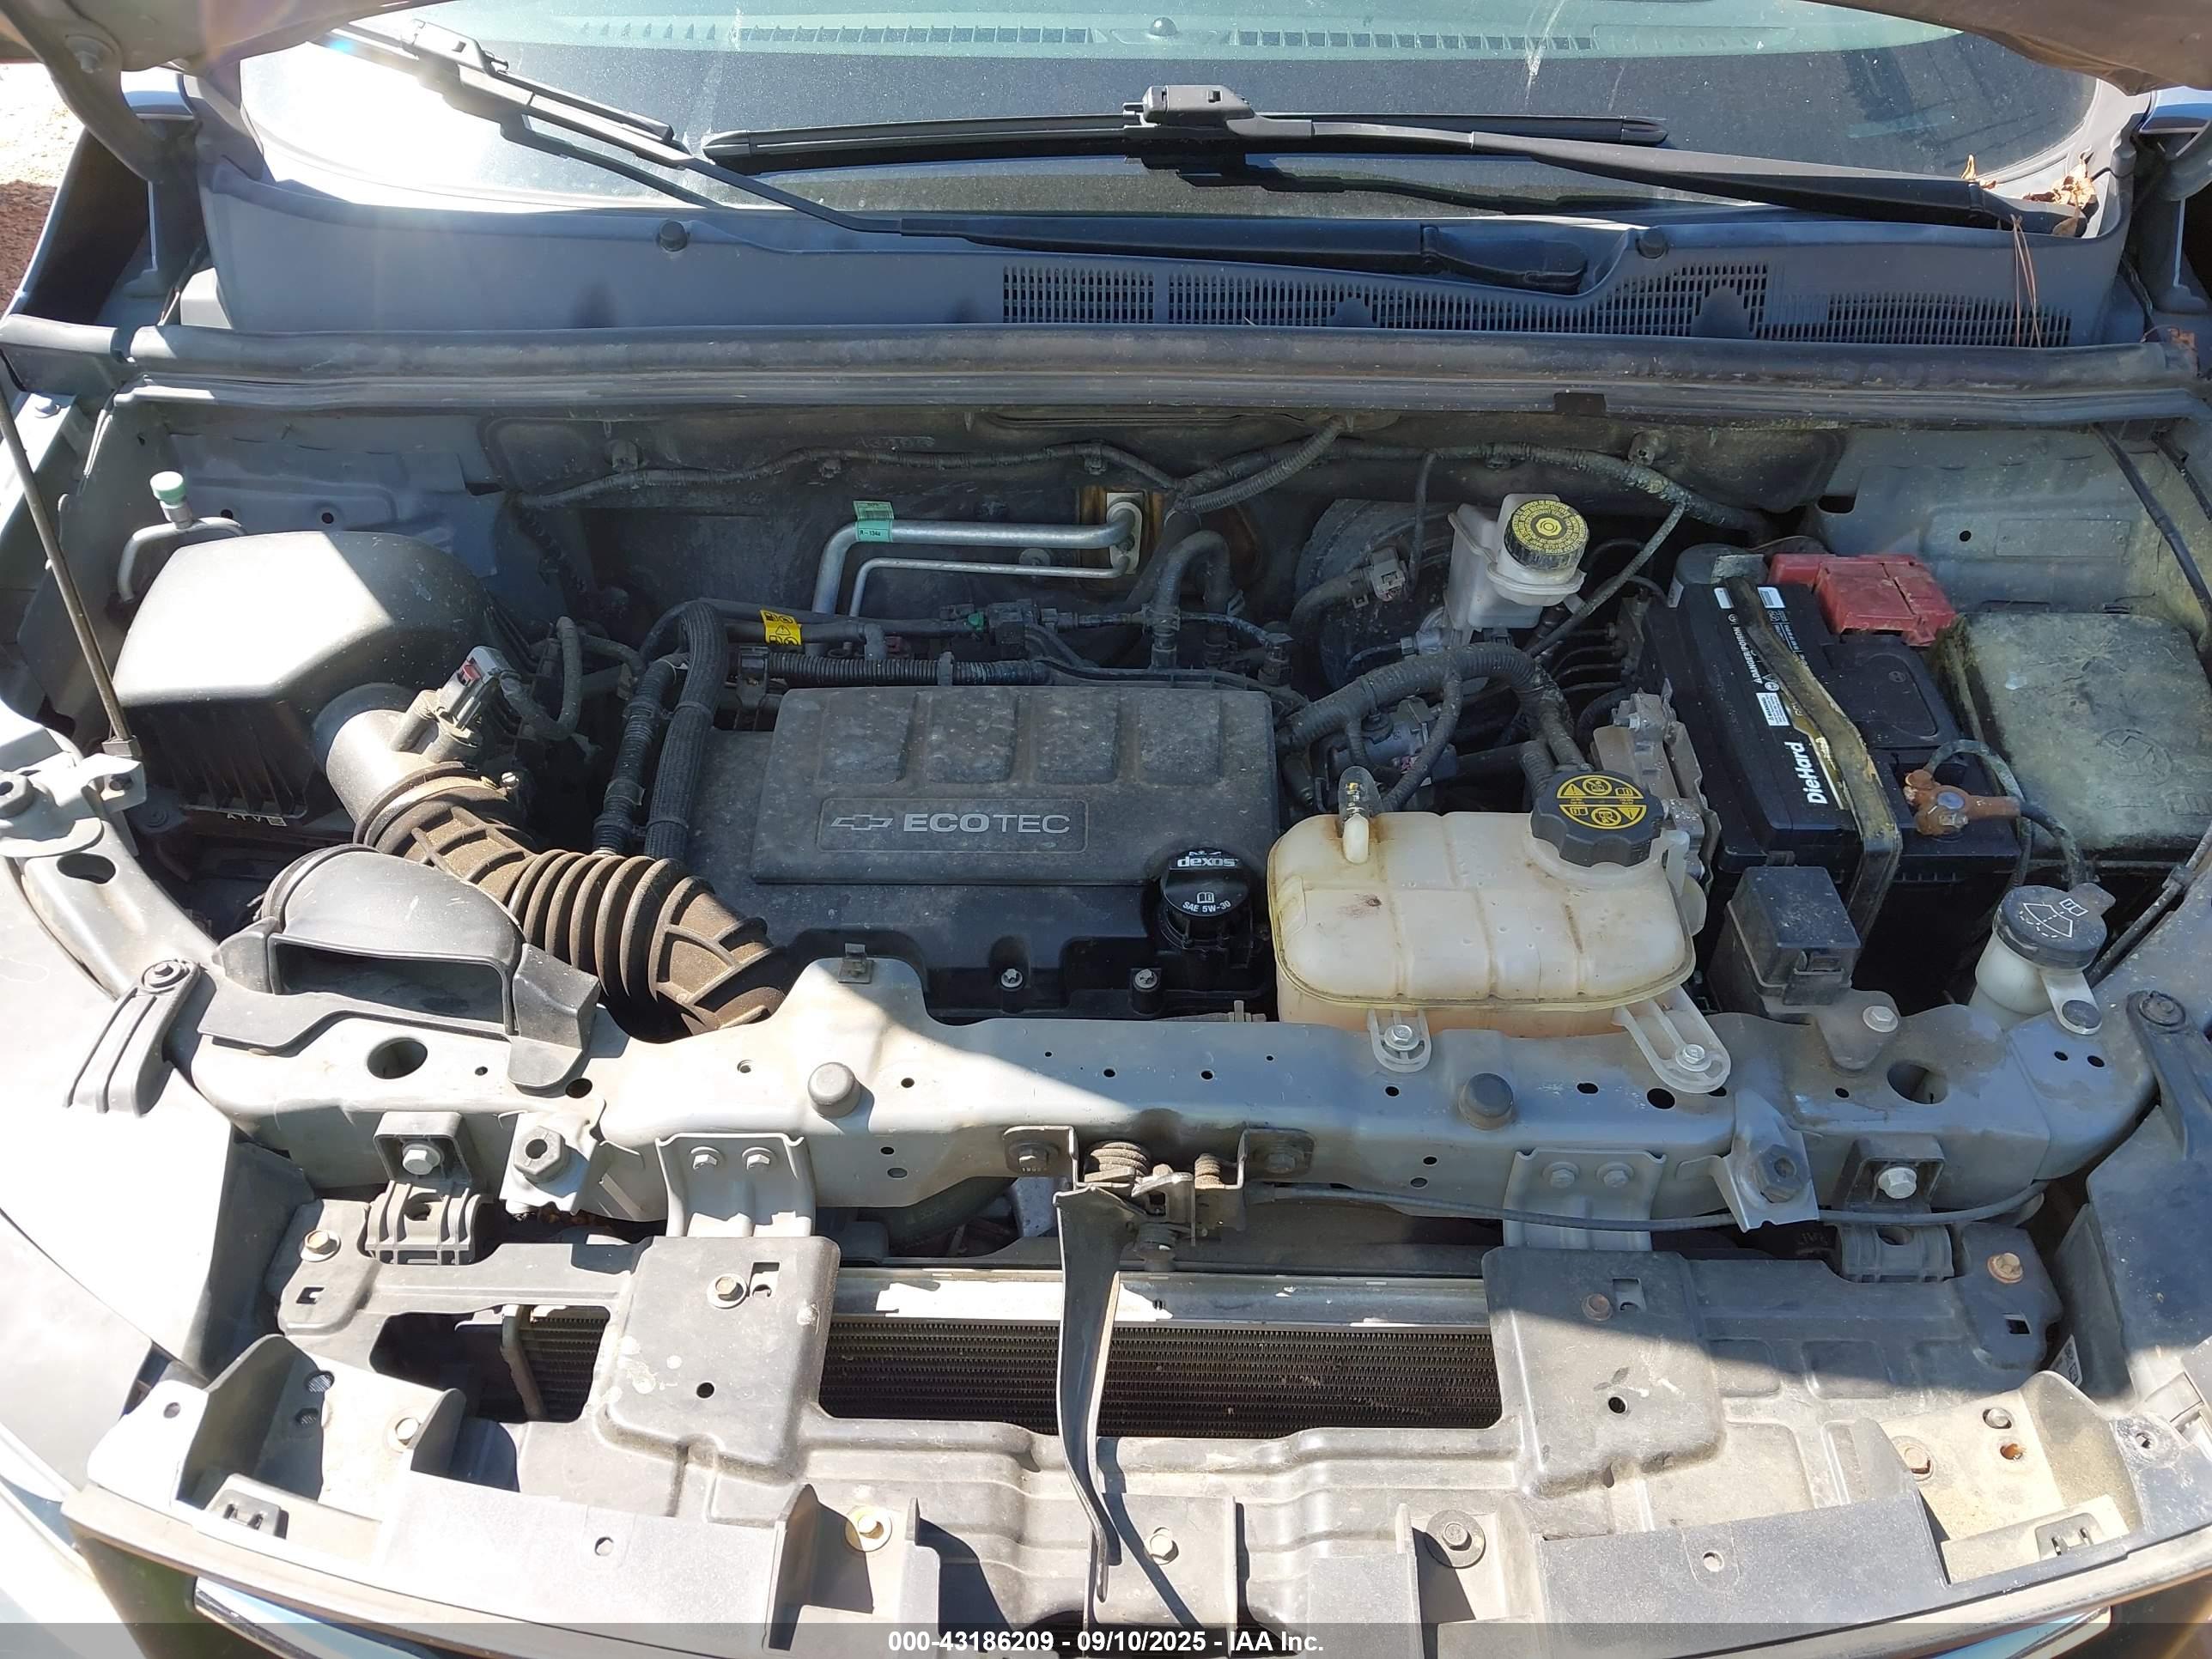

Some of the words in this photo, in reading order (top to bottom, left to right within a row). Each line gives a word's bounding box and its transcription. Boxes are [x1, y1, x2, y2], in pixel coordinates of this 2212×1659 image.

[1733, 626, 1760, 678] DANGER/POISON
[1784, 742, 1828, 805] DieHard
[903, 813, 1071, 834] ECOTEC
[1177, 856, 1236, 867] dexos
[1182, 901, 1200, 912] SAE
[1202, 900, 1231, 913] 5W-30
